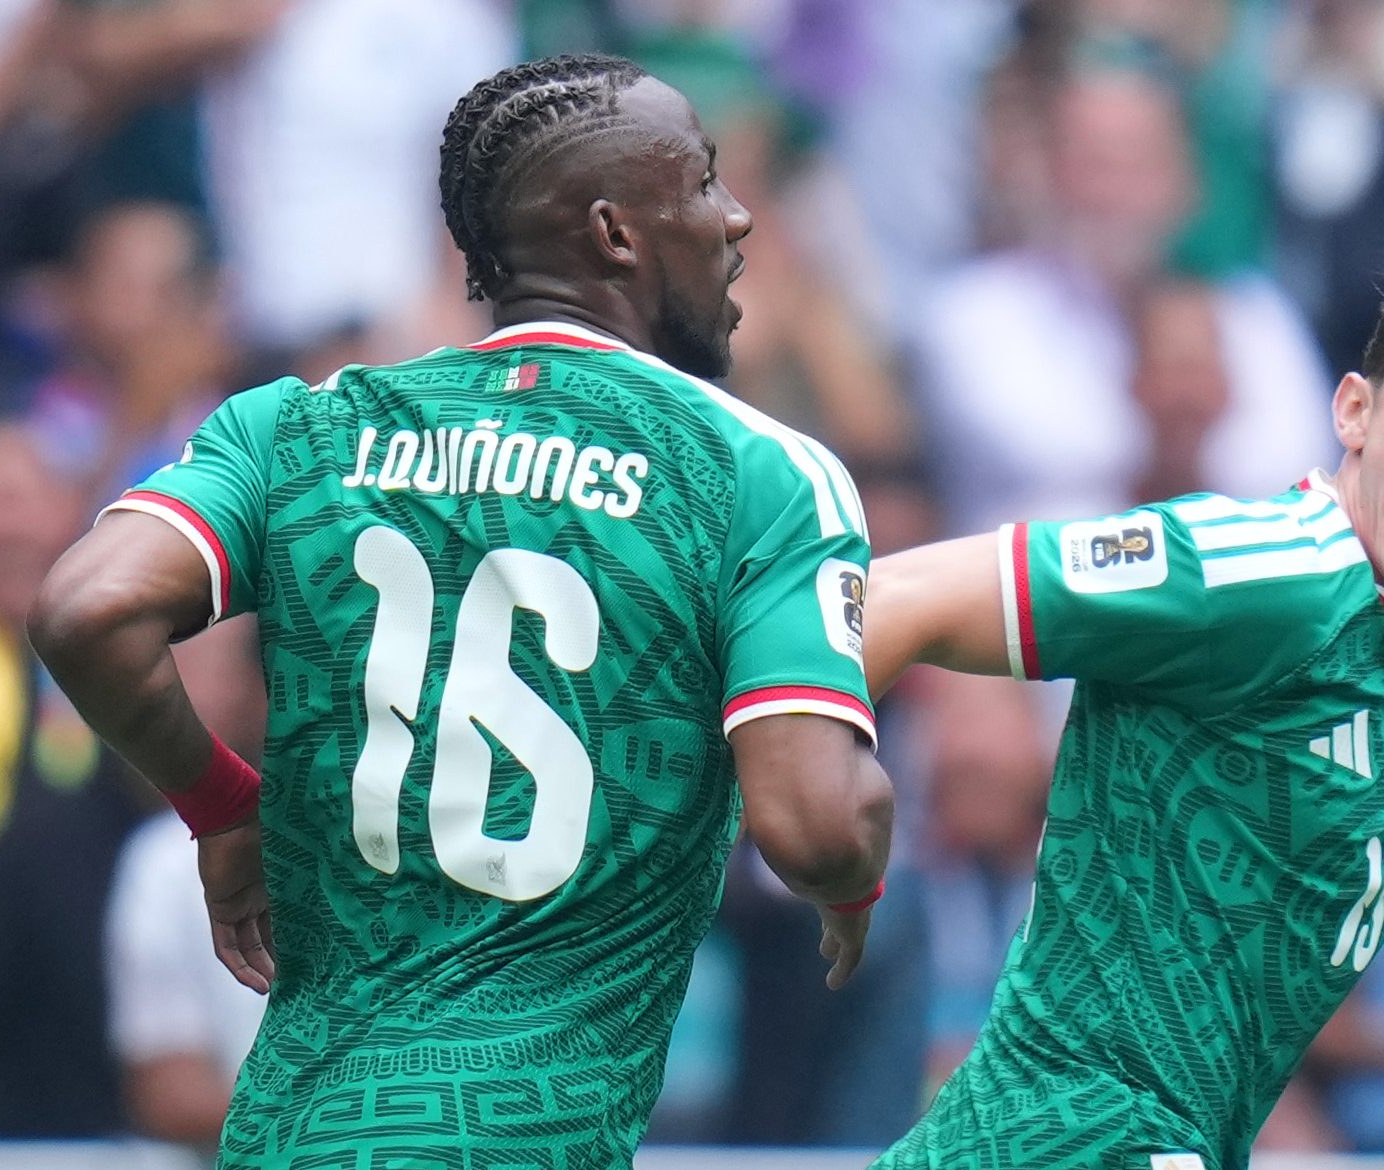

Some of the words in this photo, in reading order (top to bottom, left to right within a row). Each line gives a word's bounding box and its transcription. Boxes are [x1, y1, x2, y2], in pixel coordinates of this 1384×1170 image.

[342, 419, 649, 518] J.QUIÑONES
[1070, 539, 1082, 573] 2026
[352, 525, 600, 901] 16
